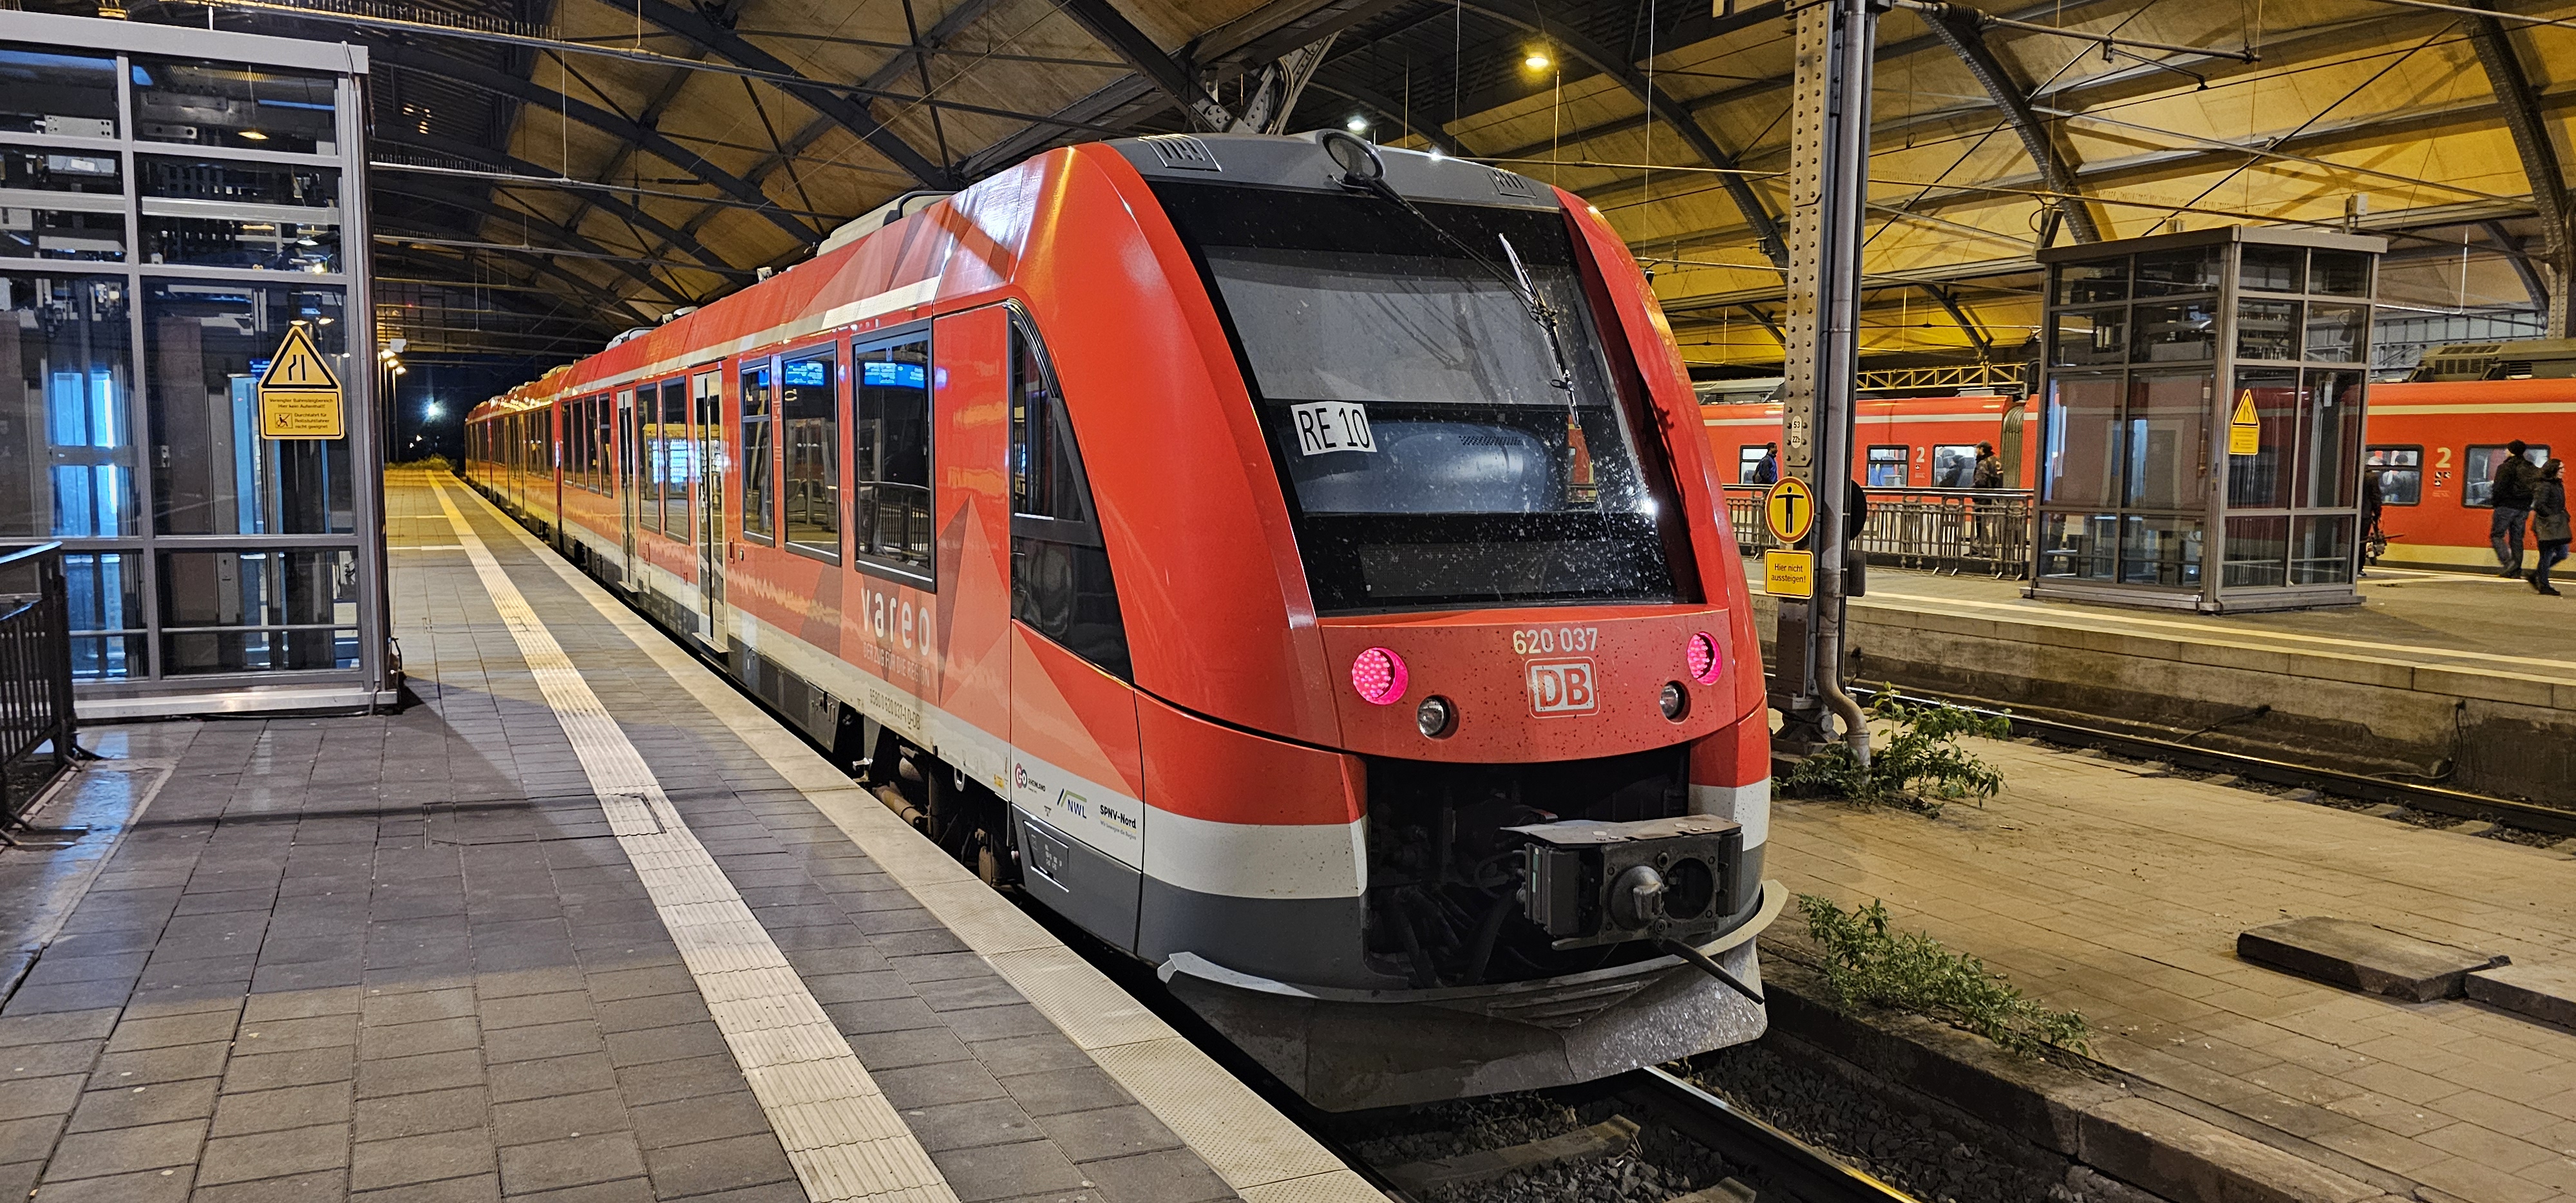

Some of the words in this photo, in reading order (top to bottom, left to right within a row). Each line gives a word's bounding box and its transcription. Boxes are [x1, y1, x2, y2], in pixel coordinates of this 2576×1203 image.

[1298, 408, 1337, 451] RE
[1338, 407, 1370, 449] 10
[1916, 446, 1925, 463] 2
[2435, 447, 2452, 468] 2
[1771, 574, 1806, 584] aussteigen!
[1774, 563, 1787, 571] Hier
[1788, 564, 1803, 573] nicht
[860, 587, 931, 657] vareo
[1513, 628, 1555, 655] 620
[1560, 627, 1598, 652] 037
[863, 641, 873, 660] DER
[873, 645, 885, 667] ZUG
[885, 648, 896, 671] FÜR
[896, 656, 907, 677] DIE
[907, 659, 931, 688] REGION
[1535, 667, 1591, 708] DB
[1067, 799, 1087, 819] NWL
[1099, 804, 1137, 829] SPNV-Nord
